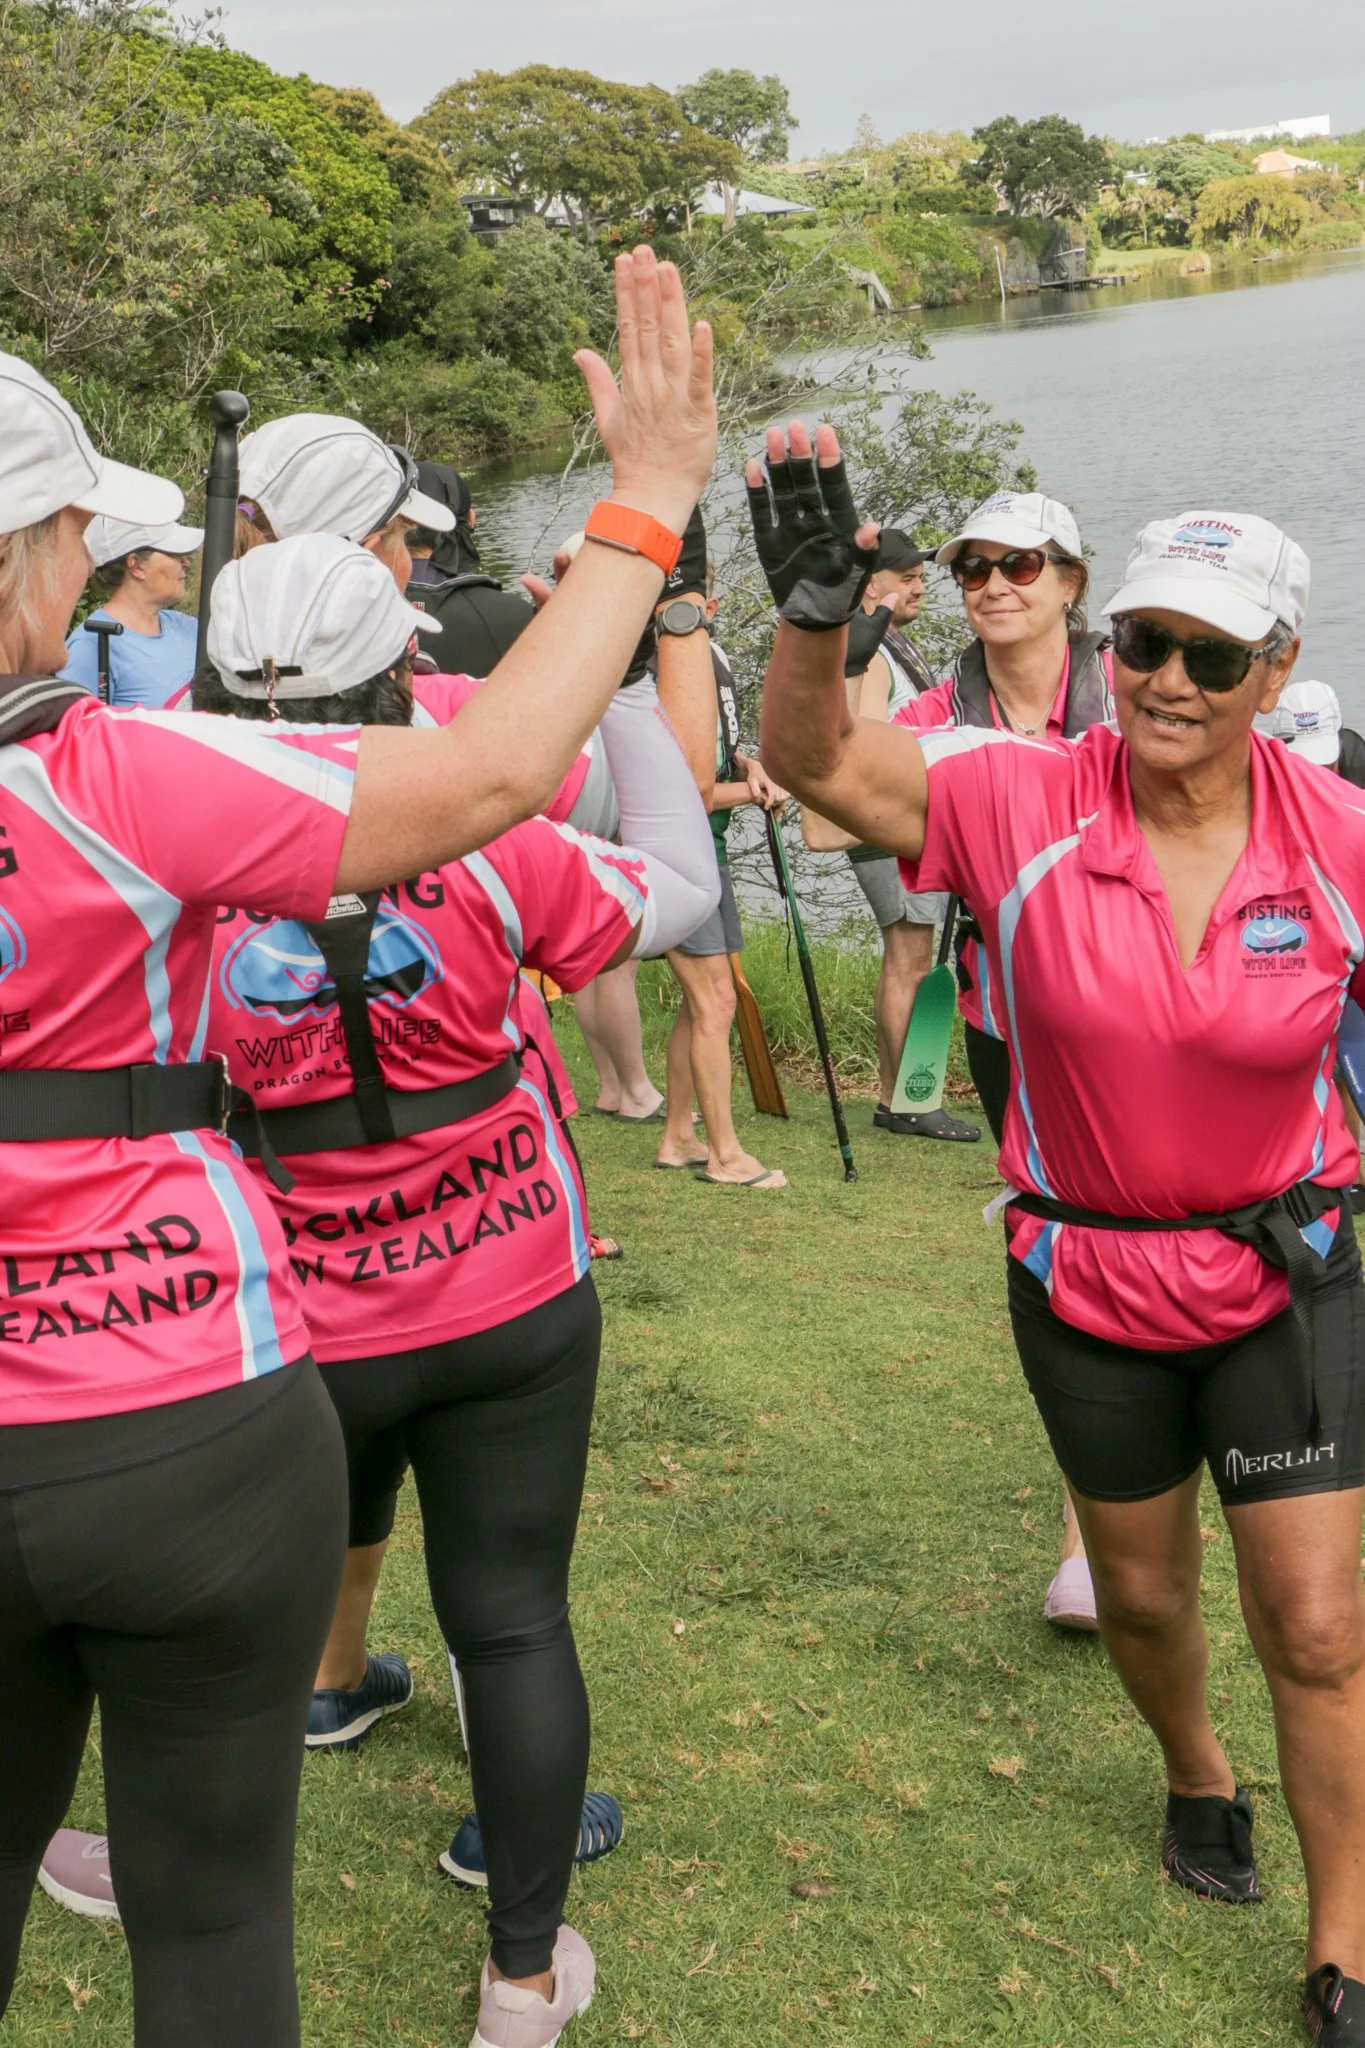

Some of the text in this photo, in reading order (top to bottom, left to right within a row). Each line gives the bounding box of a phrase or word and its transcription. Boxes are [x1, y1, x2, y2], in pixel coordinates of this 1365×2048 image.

[1209, 561, 1229, 571] TEAM
[1238, 904, 1312, 921] BUSTING
[1242, 957, 1306, 971] WITH LIFE
[236, 1016, 441, 1069] WITH IFE
[254, 1066, 326, 1091] DRAGON
[281, 1123, 538, 1247] CKLAND
[3, 1214, 201, 1297] LAND
[344, 1179, 557, 1284] ZEALAND
[0, 1270, 219, 1344] EALAND
